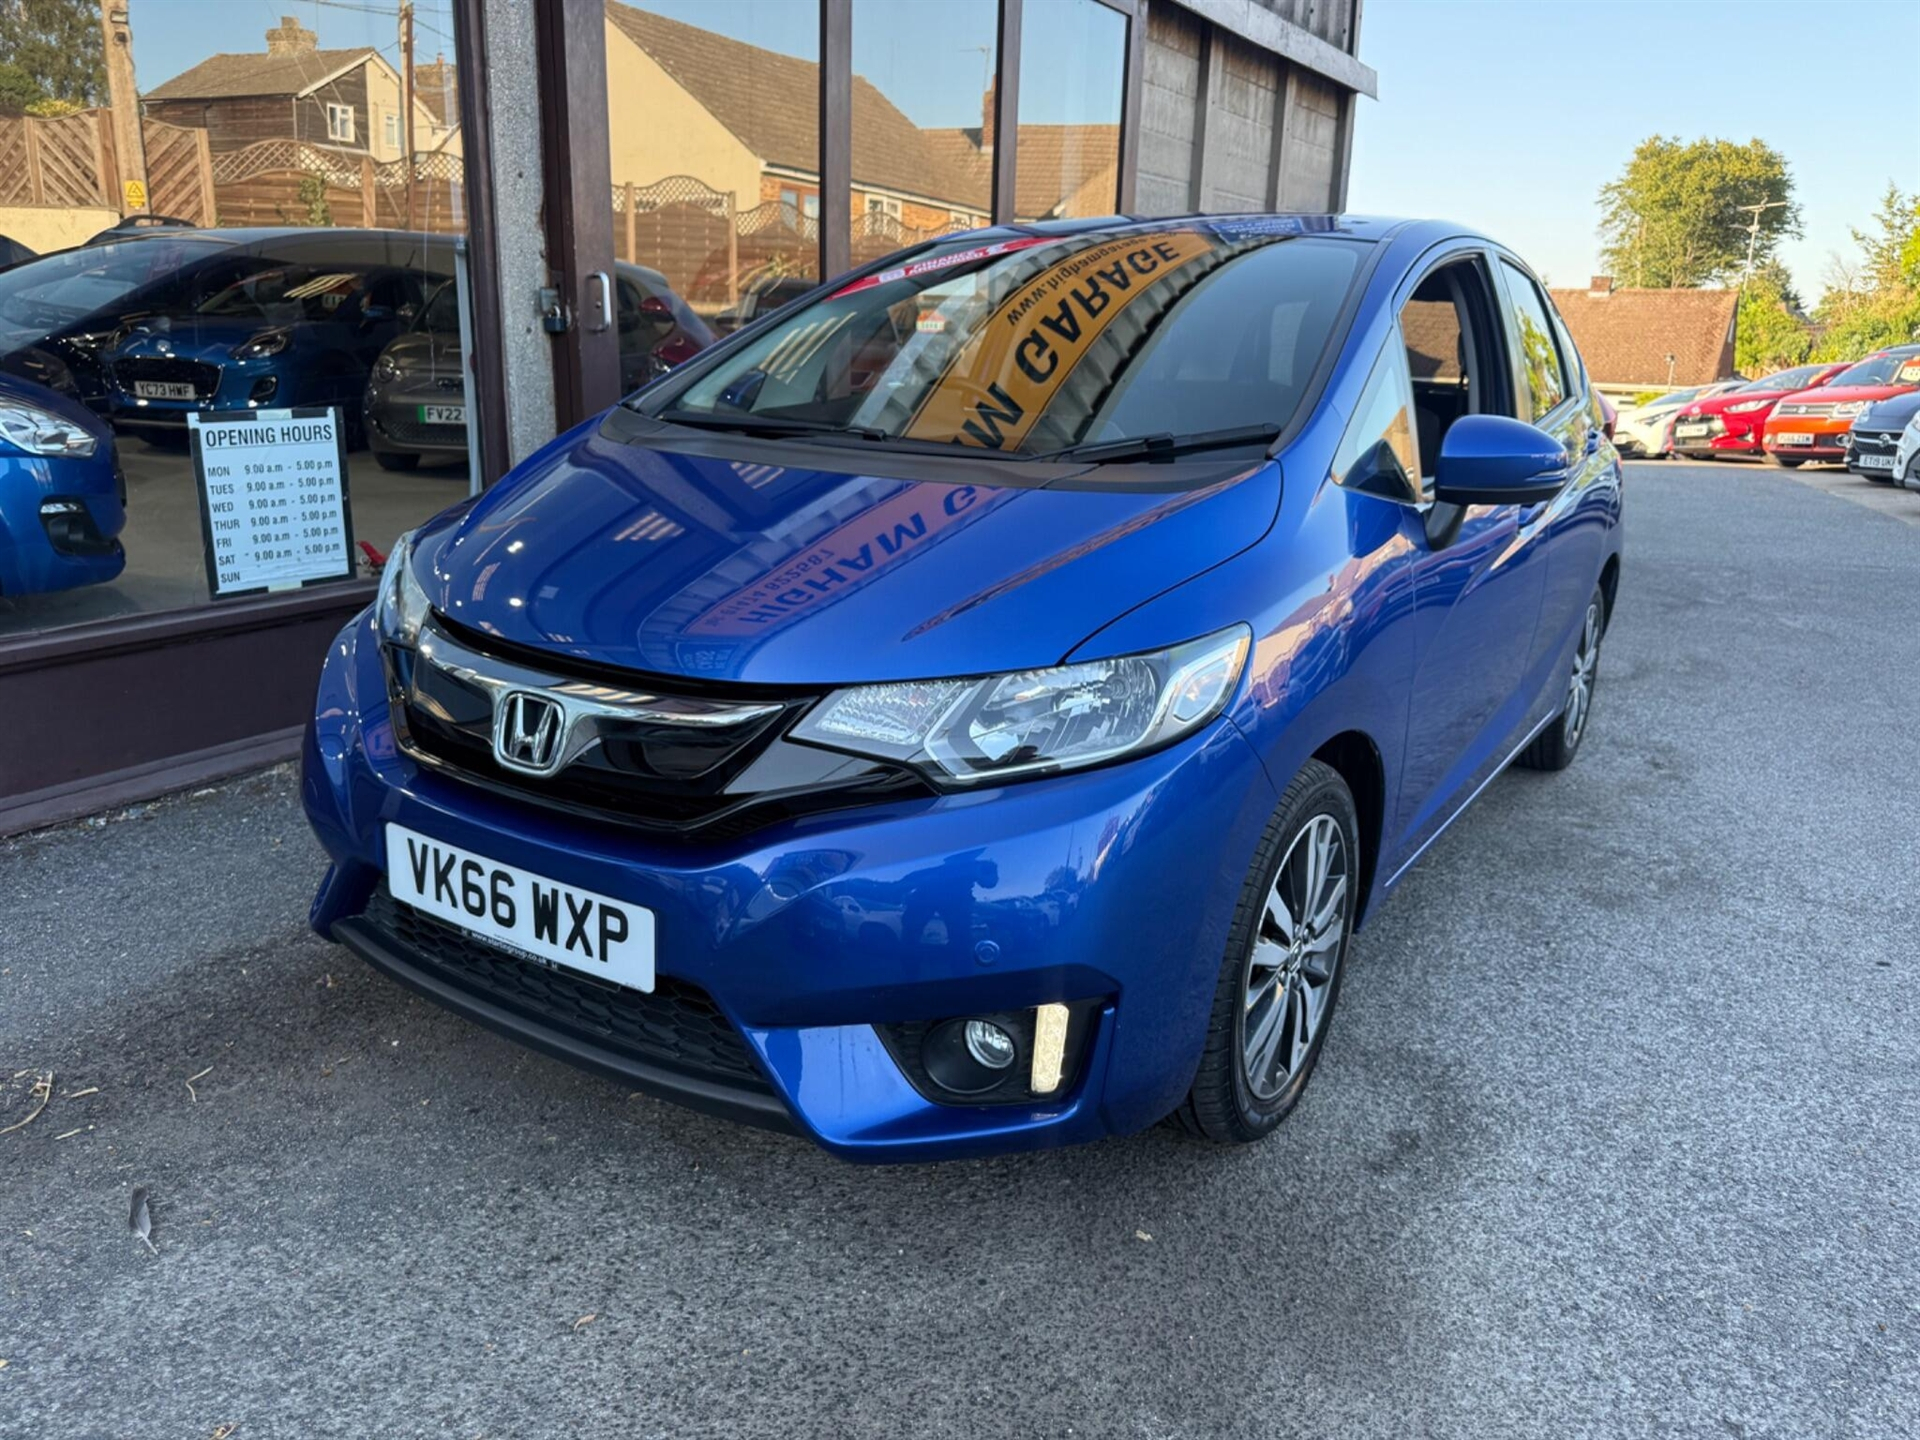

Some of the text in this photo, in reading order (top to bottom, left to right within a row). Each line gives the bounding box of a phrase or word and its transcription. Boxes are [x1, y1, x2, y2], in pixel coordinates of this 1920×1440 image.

[427, 407, 462, 421] FV22
[206, 425, 332, 447] OPENING HOURS
[208, 467, 230, 477] MON
[244, 463, 264, 475] 9.00
[297, 460, 314, 470] 5.00
[210, 484, 234, 495] TUES
[247, 481, 266, 492] 9.00
[298, 477, 316, 487] 5.00
[212, 502, 233, 513] WED
[249, 499, 268, 510] 9.00
[300, 494, 318, 504] 5.00
[214, 519, 240, 530] THUR
[251, 516, 270, 527] 9.00
[302, 510, 319, 521] 5.00
[216, 538, 231, 548] FRI
[252, 533, 272, 544] 9.00
[303, 528, 321, 538] 5.00
[219, 555, 235, 565] SAT
[255, 550, 274, 561] 9.00
[305, 544, 322, 555] 5.00
[221, 572, 240, 583] SUN
[408, 838, 628, 963] VK66 WXP
